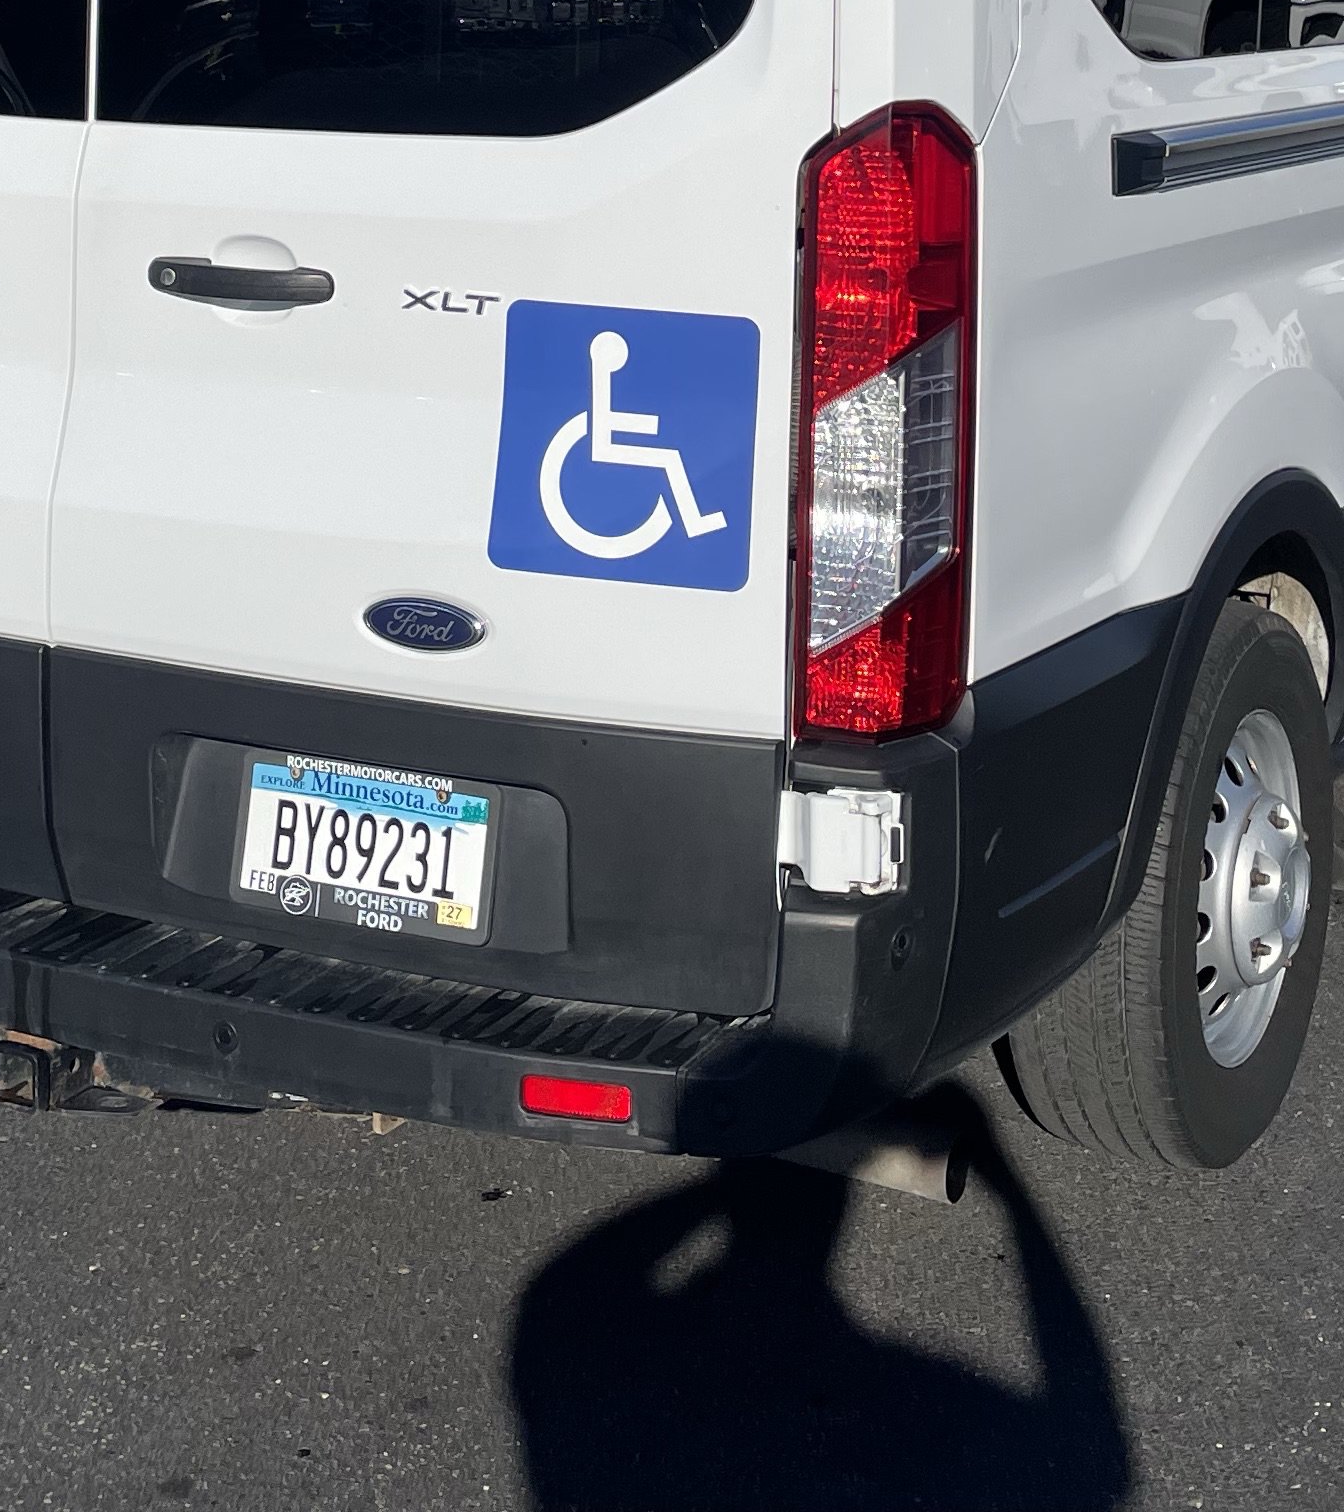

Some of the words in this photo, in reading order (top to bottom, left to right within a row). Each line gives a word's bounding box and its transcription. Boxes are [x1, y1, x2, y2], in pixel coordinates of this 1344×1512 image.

[401, 288, 502, 316] XLT
[386, 606, 455, 642] Ford
[286, 755, 454, 793] ROCHESTERMOTORCARS.COM
[271, 798, 454, 900] BY89231
[249, 869, 276, 892] FEB
[333, 887, 429, 920] ROCHESTER
[446, 905, 463, 920] 27
[356, 910, 403, 933] FORD
